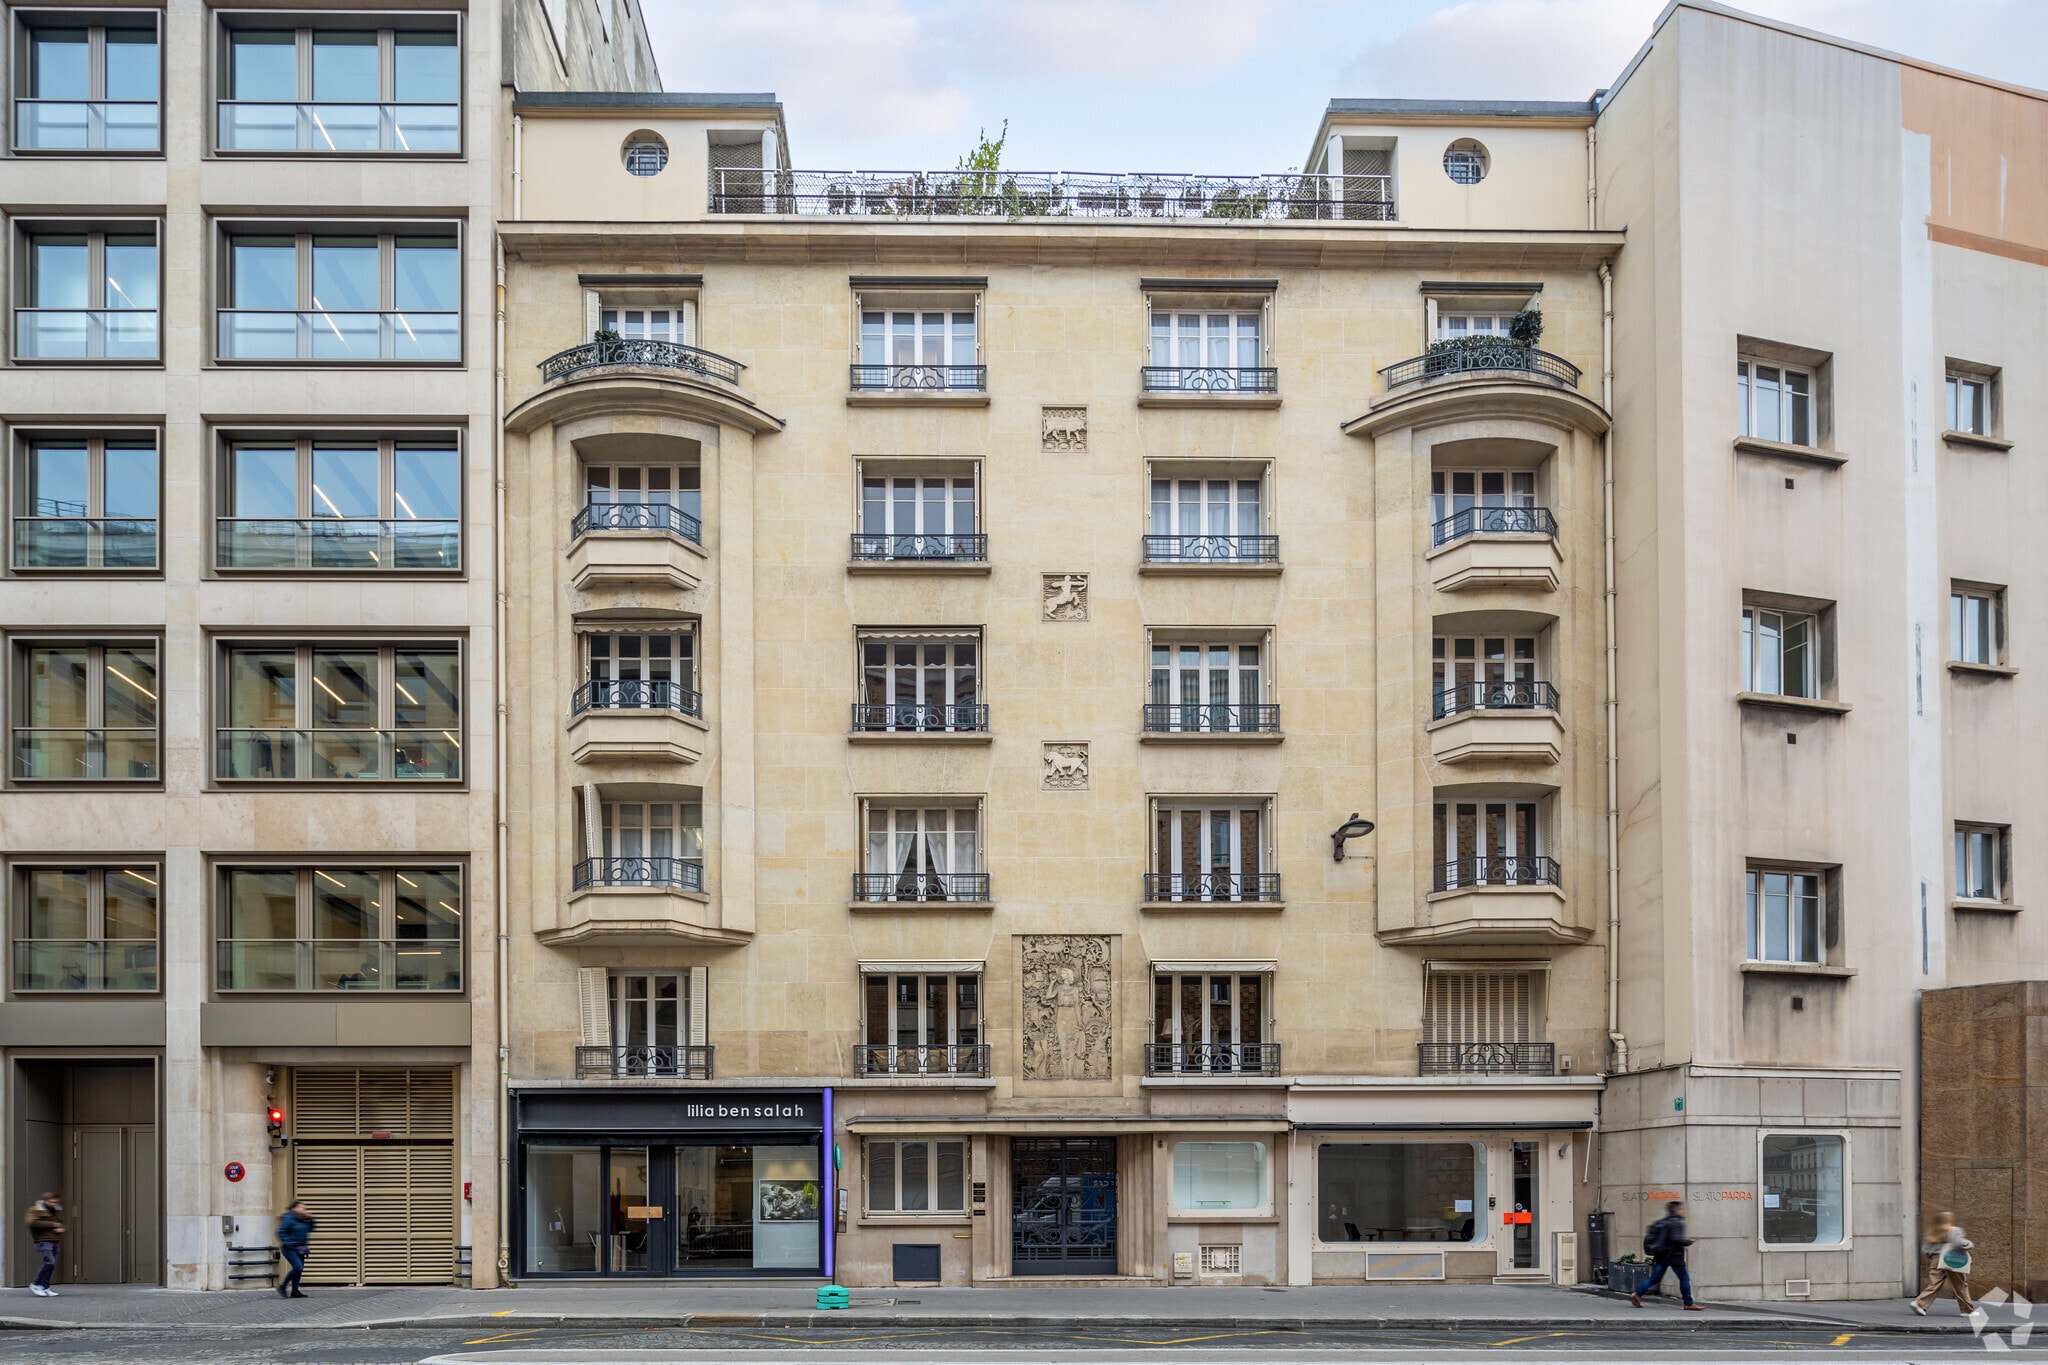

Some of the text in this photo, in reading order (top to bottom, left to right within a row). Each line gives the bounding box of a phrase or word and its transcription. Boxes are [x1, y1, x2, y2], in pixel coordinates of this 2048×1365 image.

[687, 1104, 804, 1117] lilia ben salah
